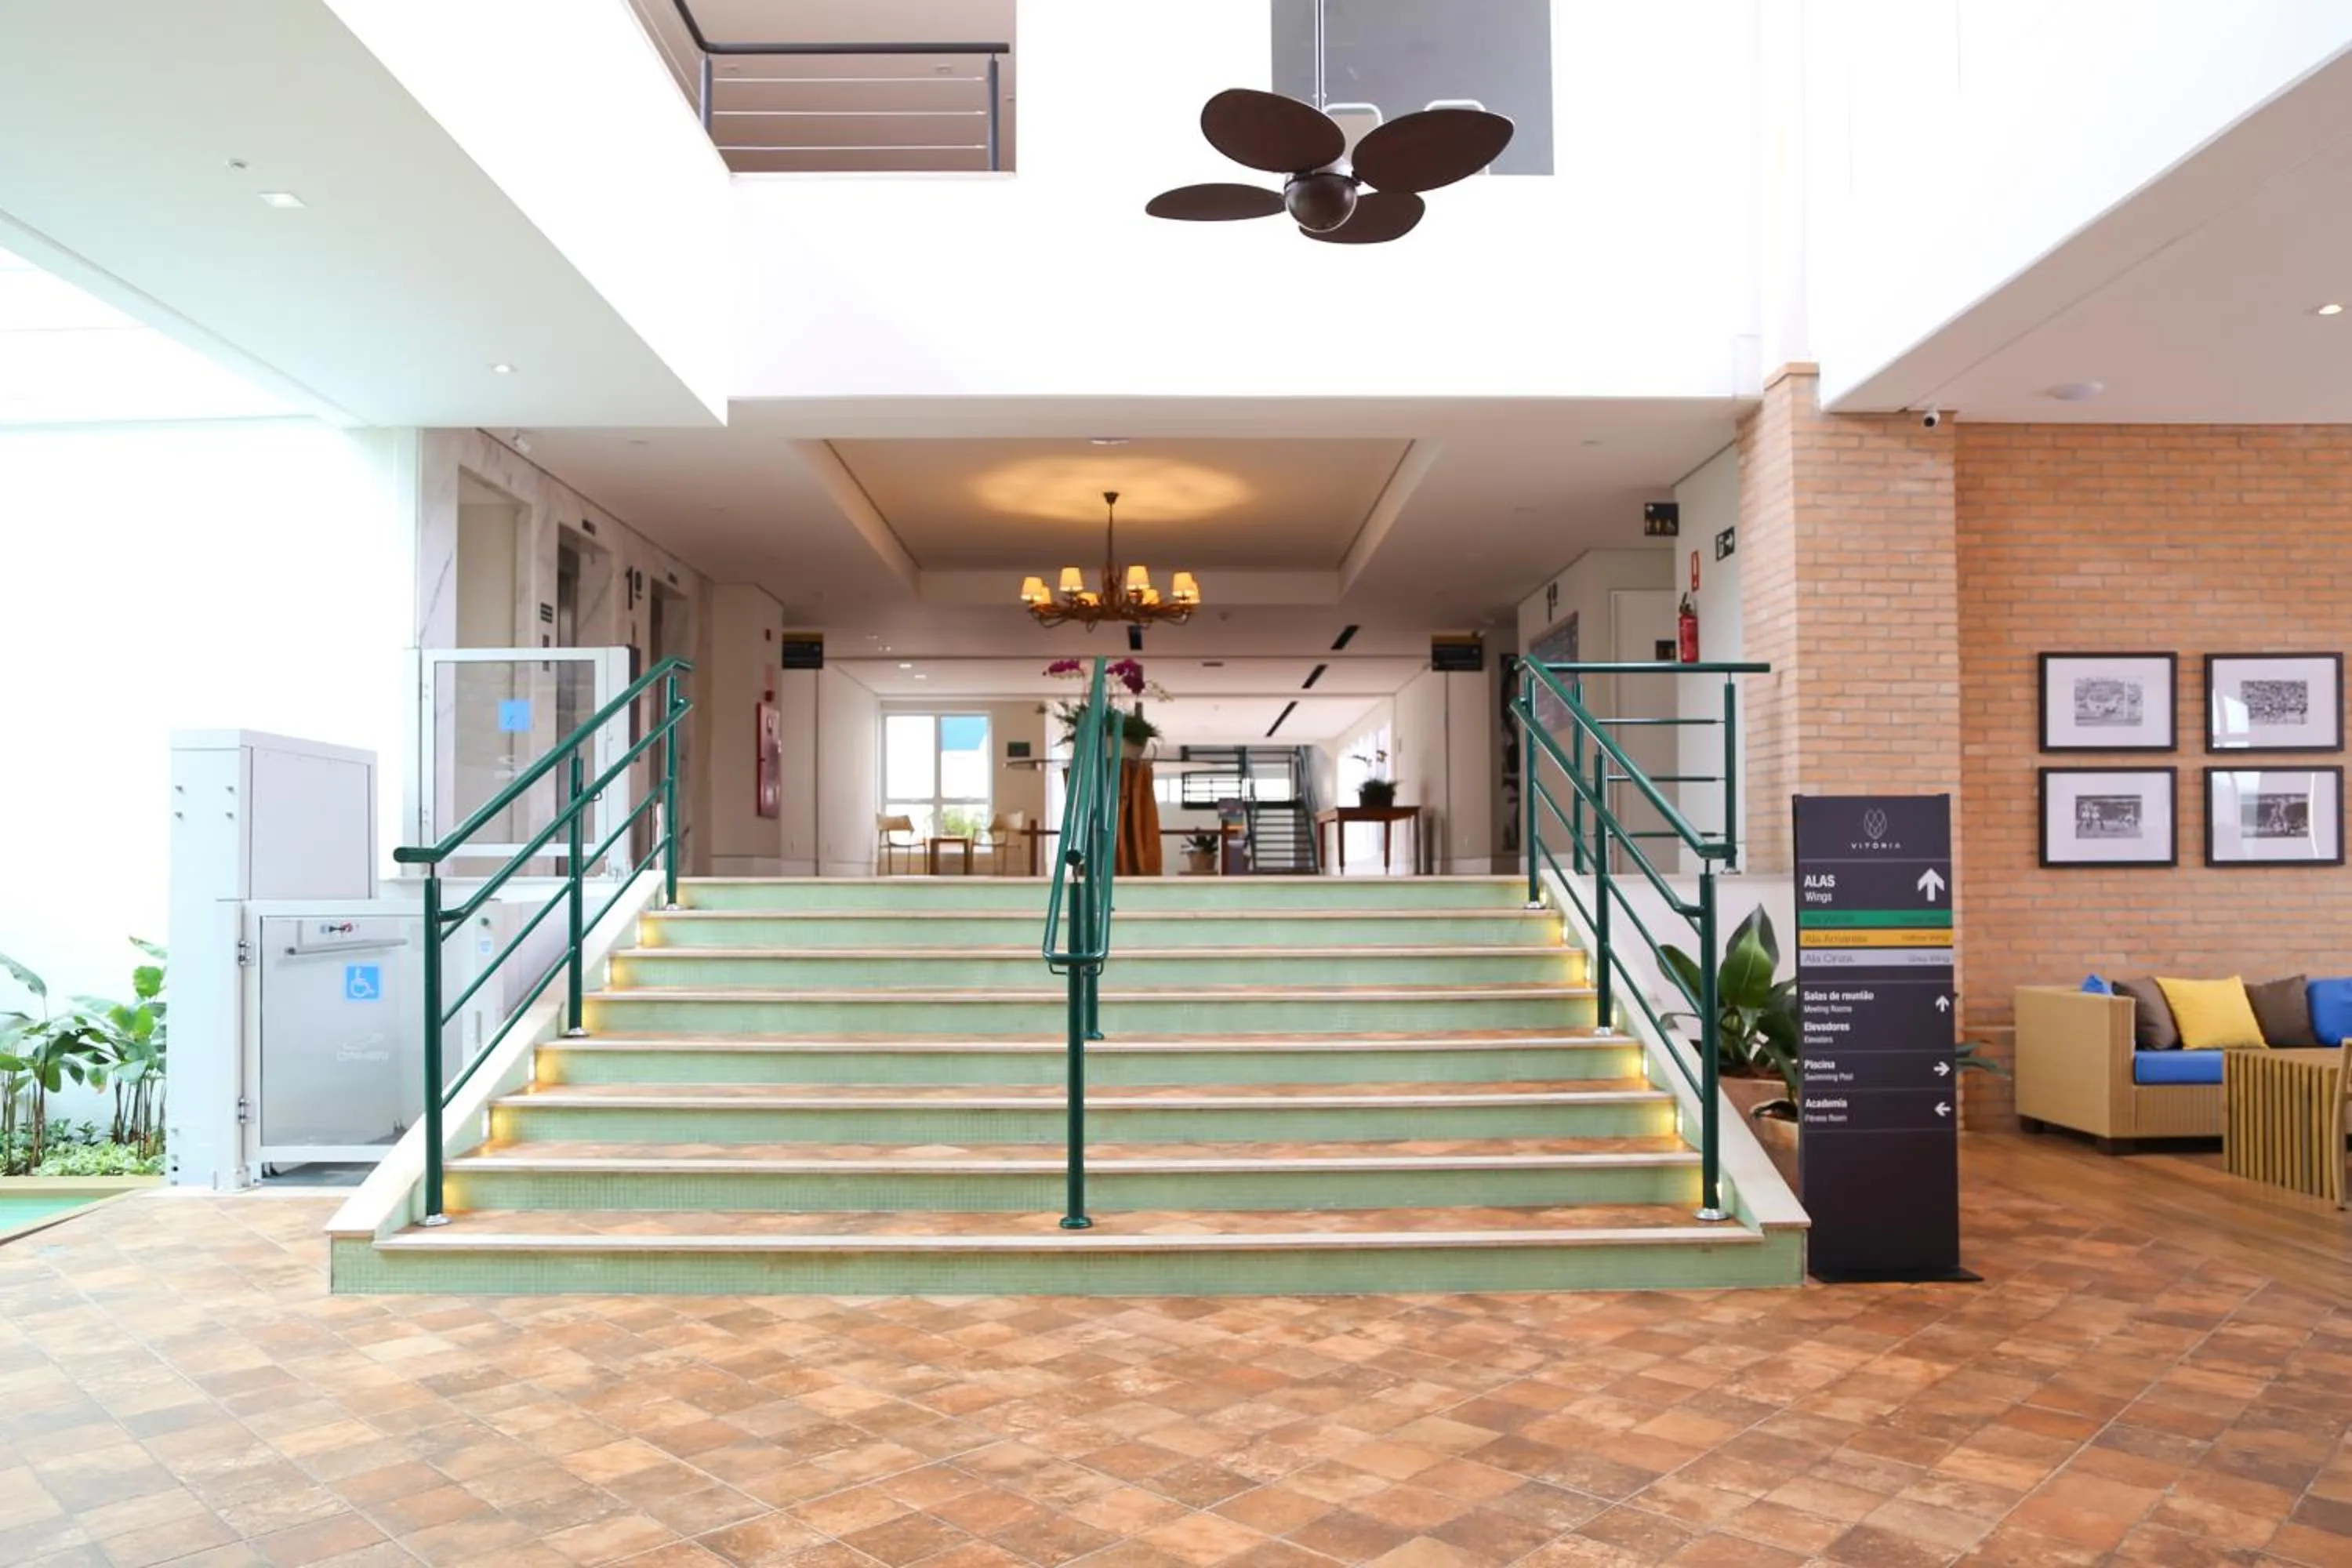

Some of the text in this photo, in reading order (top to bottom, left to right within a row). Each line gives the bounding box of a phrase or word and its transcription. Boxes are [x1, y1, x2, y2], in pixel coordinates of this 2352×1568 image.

[1804, 874, 1835, 887] ALAS
[1805, 891, 1832, 903] Wings
[1804, 990, 1875, 1001] Salas de reunião
[1804, 1021, 1850, 1032] Elevadores
[1804, 1059, 1835, 1070] Piscina
[1805, 1098, 1848, 1109] Academia
